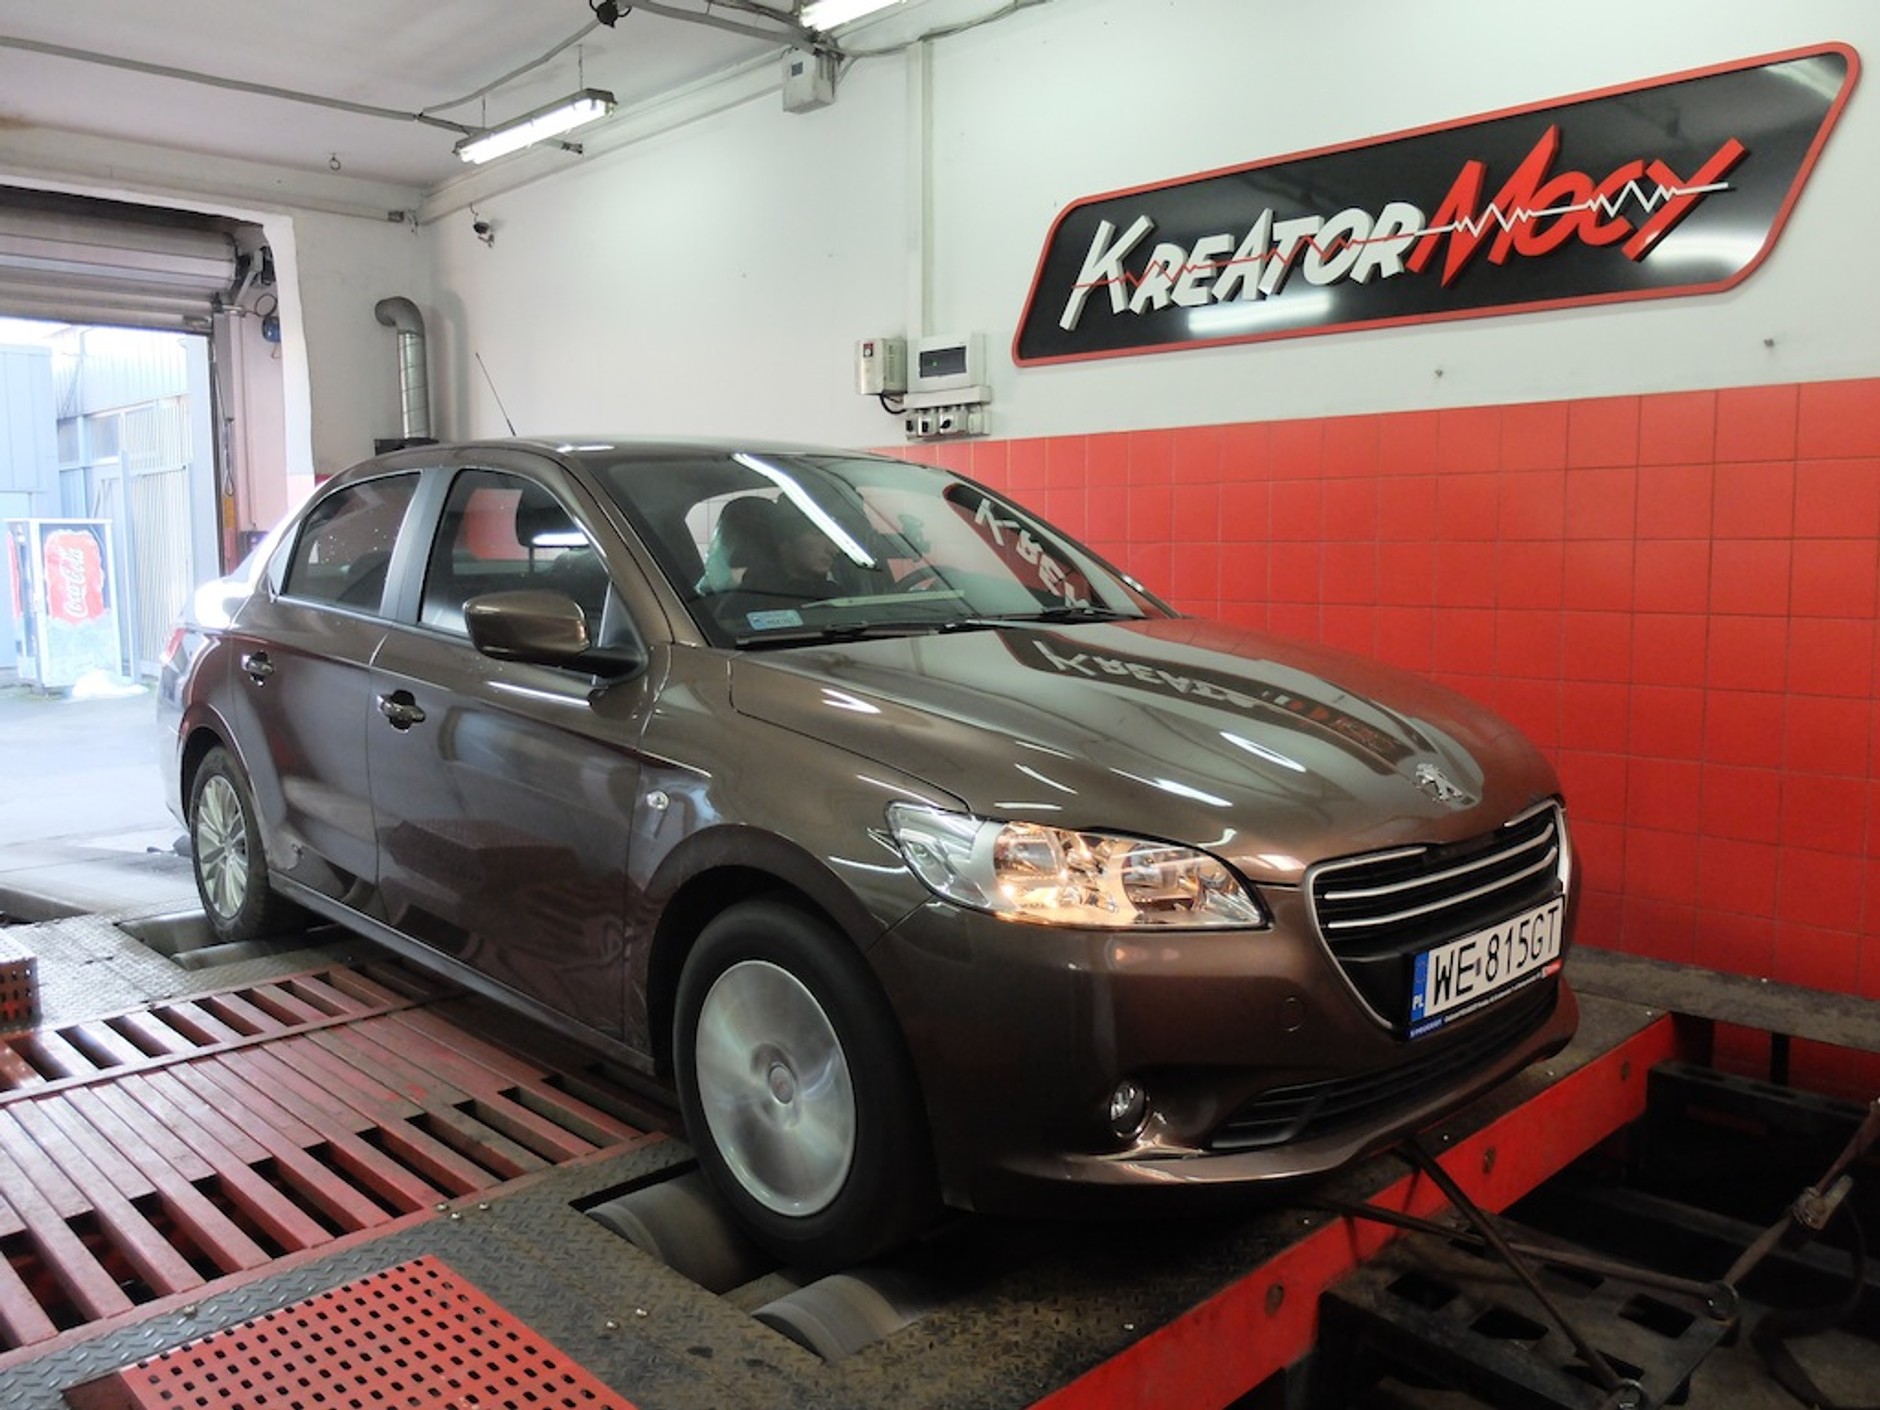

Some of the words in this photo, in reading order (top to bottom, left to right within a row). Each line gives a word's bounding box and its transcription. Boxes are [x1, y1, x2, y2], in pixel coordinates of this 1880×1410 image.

[1434, 942, 1477, 1006] WE
[1485, 905, 1560, 983] 815GT
[1412, 994, 1425, 1011] PL
